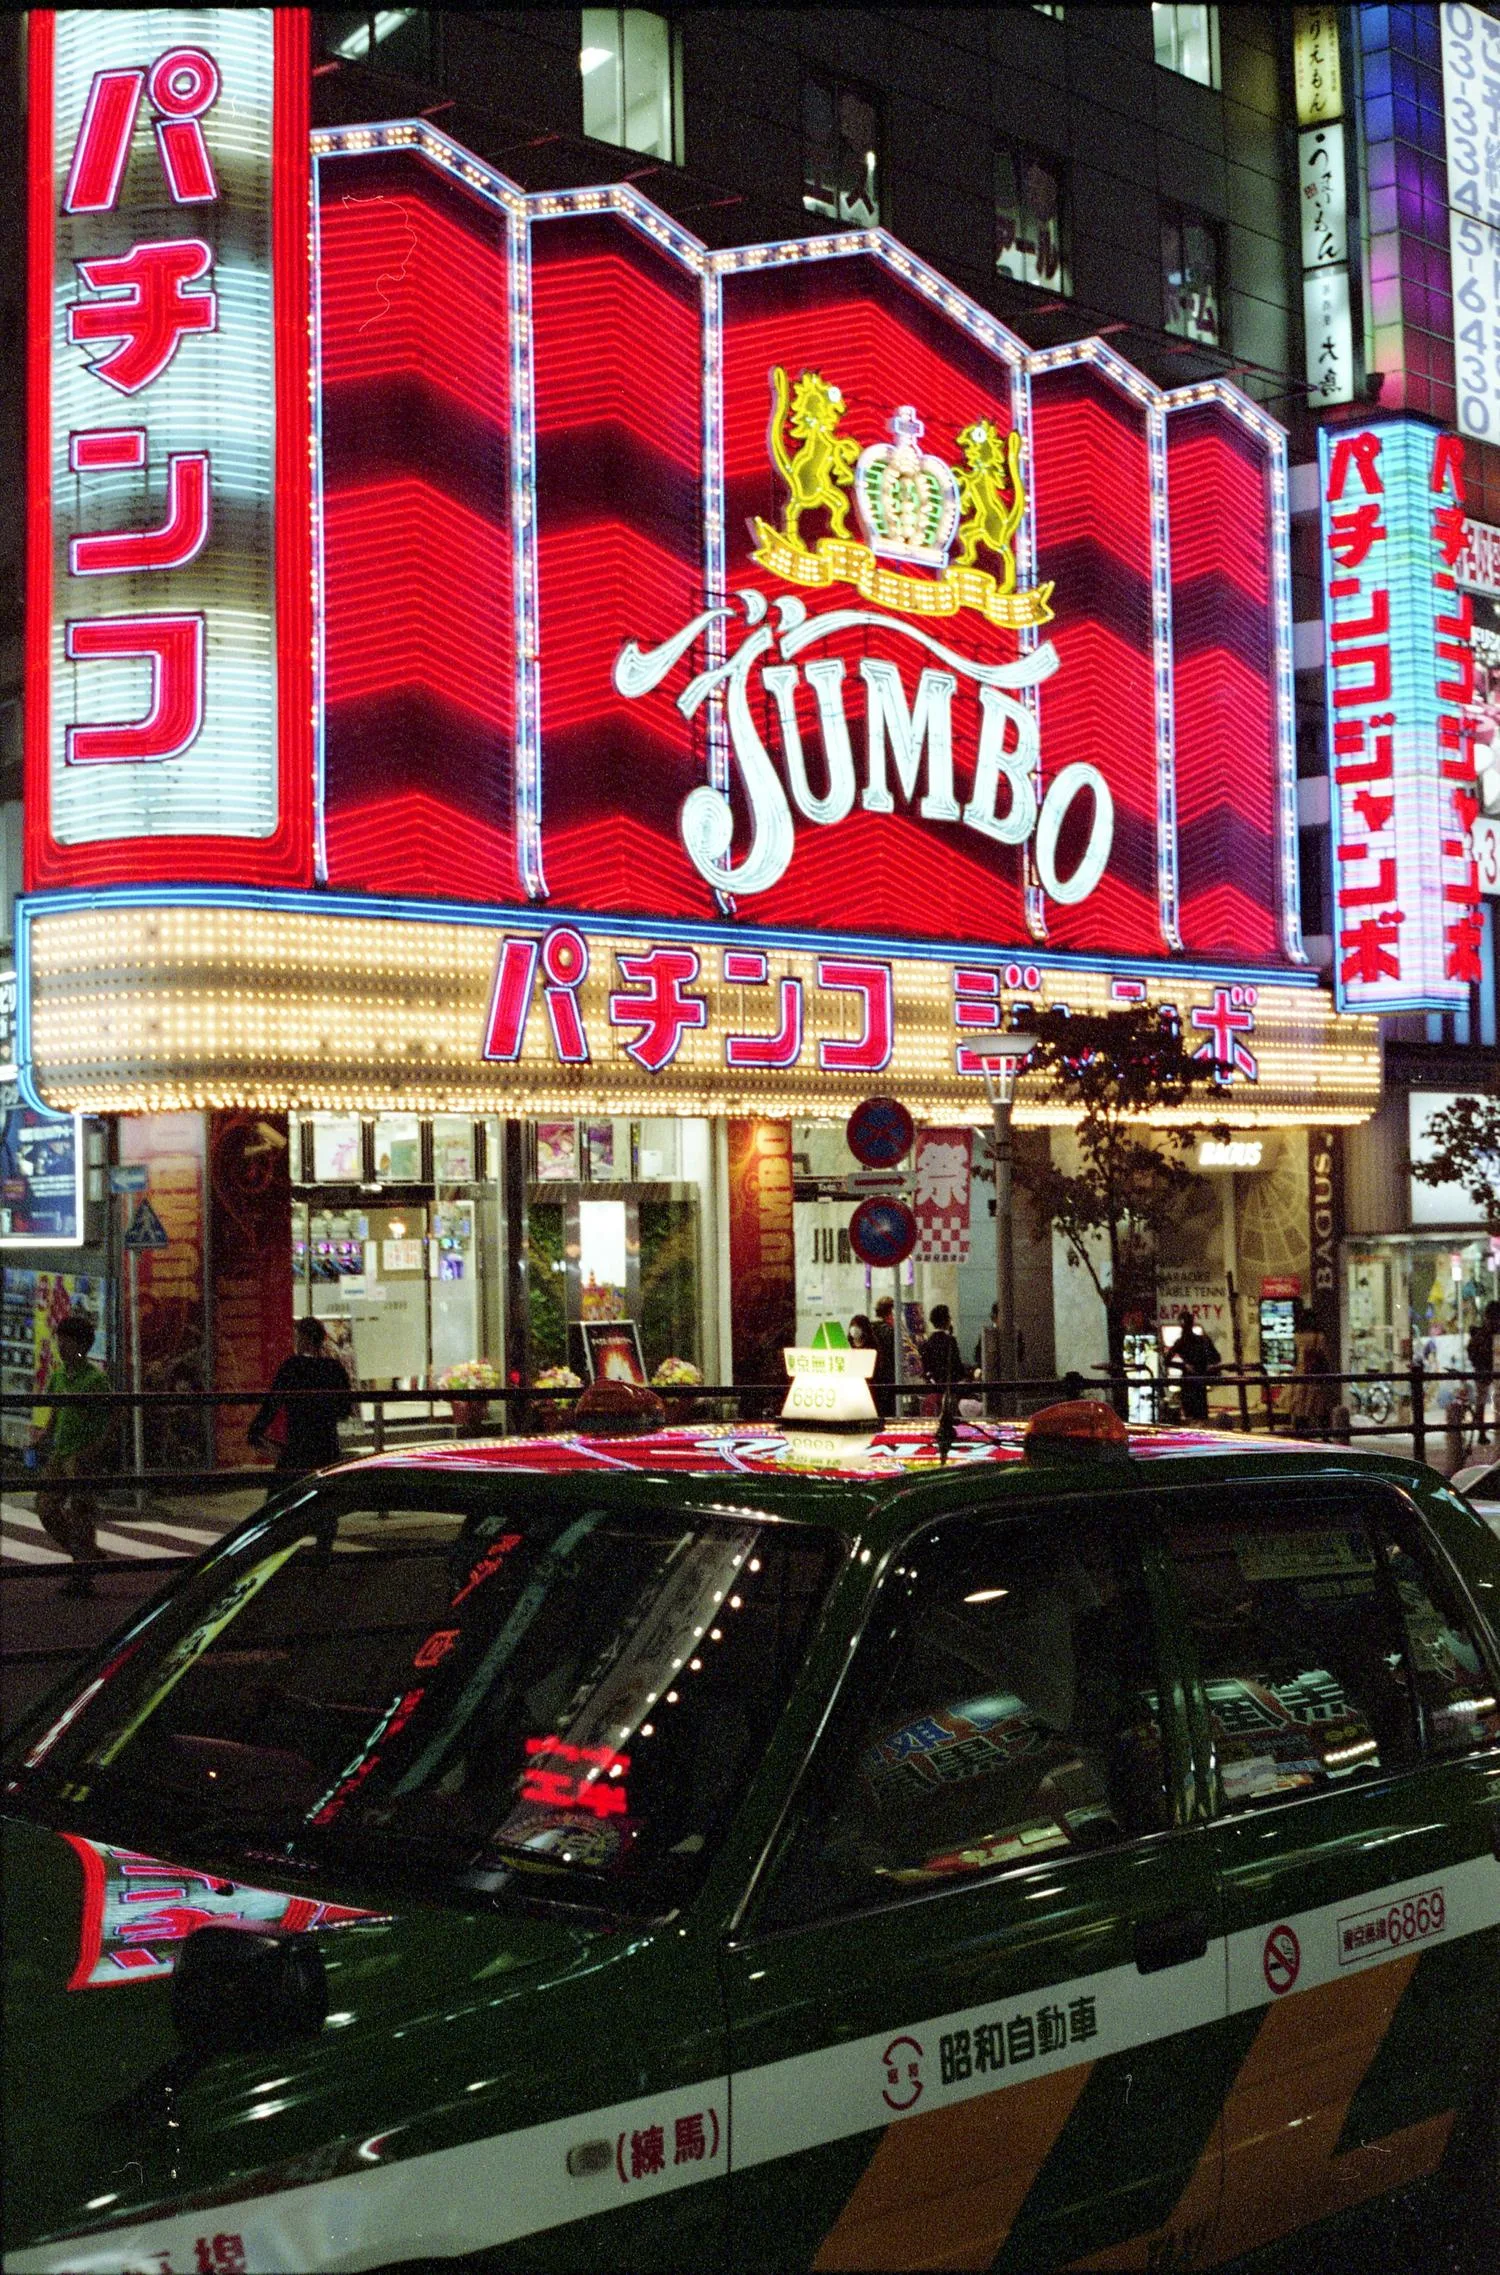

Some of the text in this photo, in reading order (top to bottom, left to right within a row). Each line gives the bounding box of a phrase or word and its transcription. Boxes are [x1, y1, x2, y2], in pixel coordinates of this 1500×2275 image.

[64, 45, 223, 767] パチンコ
[1431, 434, 1475, 704] パチンコ
[615, 588, 1115, 906] JUMBO
[1326, 431, 1404, 983] パチンコ ジャンボ
[1439, 714, 1486, 983] ジャンボ
[484, 924, 1259, 1086] パチンコ ジボ
[792, 1387, 836, 1409] 6869
[1388, 1892, 1445, 1945] 6869
[615, 2107, 721, 2184] (練馬)
[938, 1996, 1099, 2086] 昭和自動車
